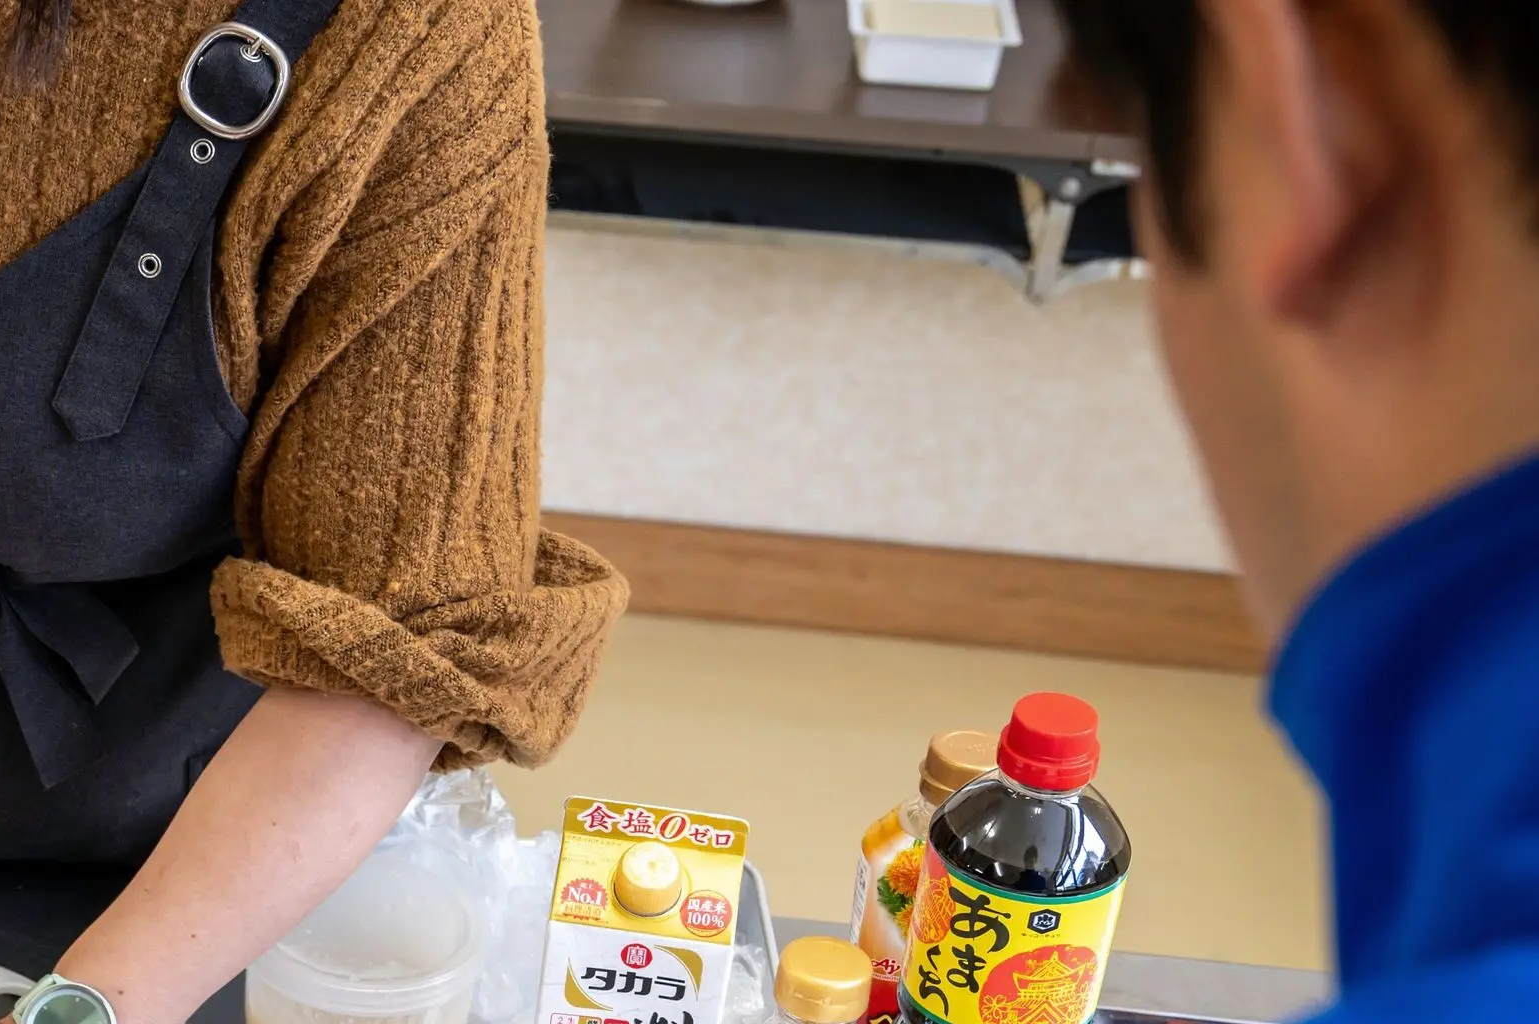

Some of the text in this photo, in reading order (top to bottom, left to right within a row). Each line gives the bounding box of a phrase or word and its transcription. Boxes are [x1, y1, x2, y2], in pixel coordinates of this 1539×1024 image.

[567, 886, 603, 906] No.1
[687, 898, 727, 915] 国産米
[687, 911, 725, 928] 100%
[581, 967, 686, 1001] タカラ
